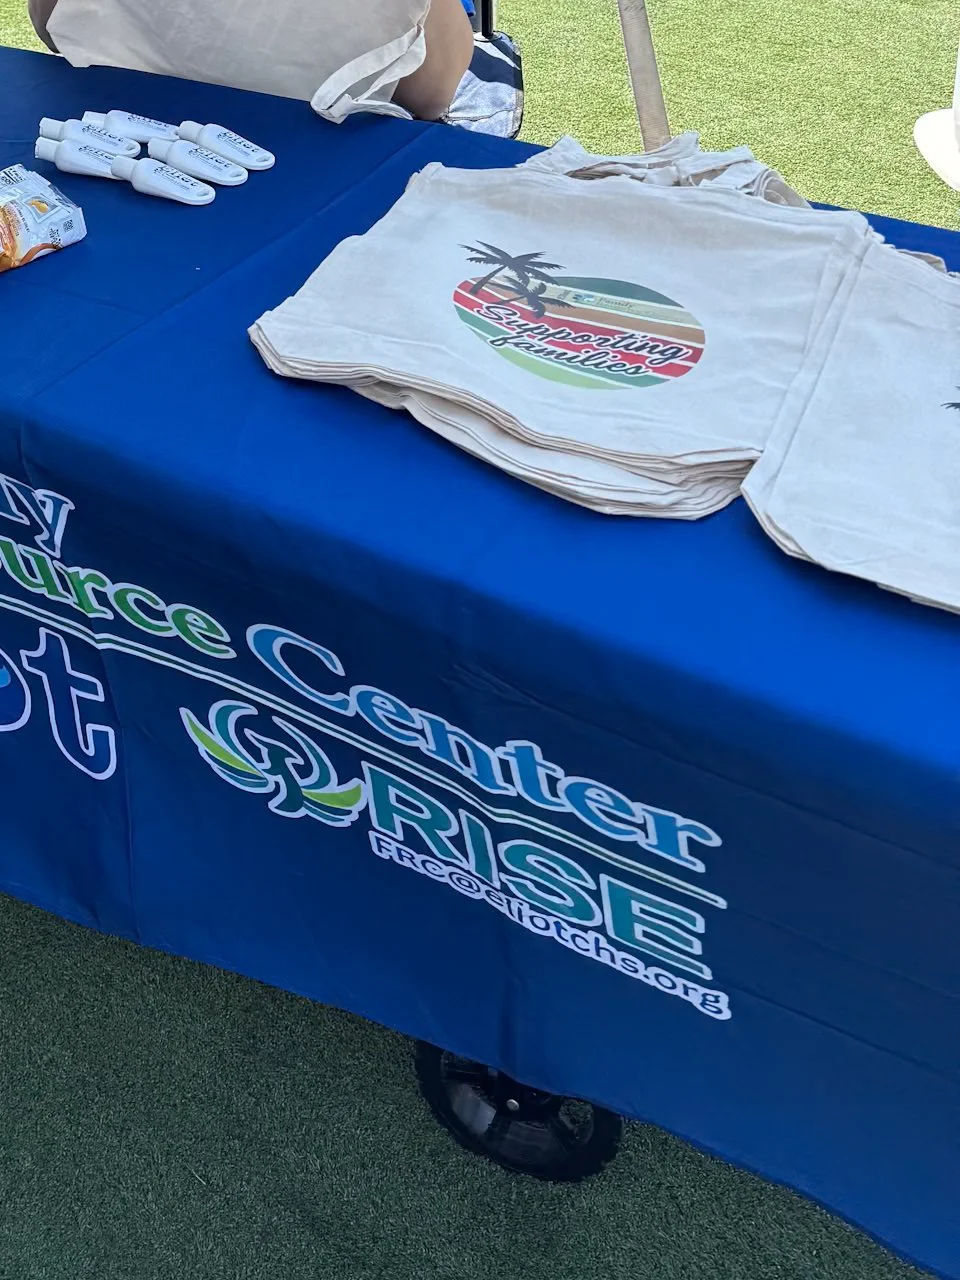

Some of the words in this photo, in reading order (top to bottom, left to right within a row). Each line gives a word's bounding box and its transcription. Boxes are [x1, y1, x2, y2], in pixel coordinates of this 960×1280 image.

[477, 305, 690, 365] Supporting
[246, 624, 722, 873] Center
[361, 761, 712, 982] RISE
[368, 830, 732, 1020] FRC@eliotchs.org
